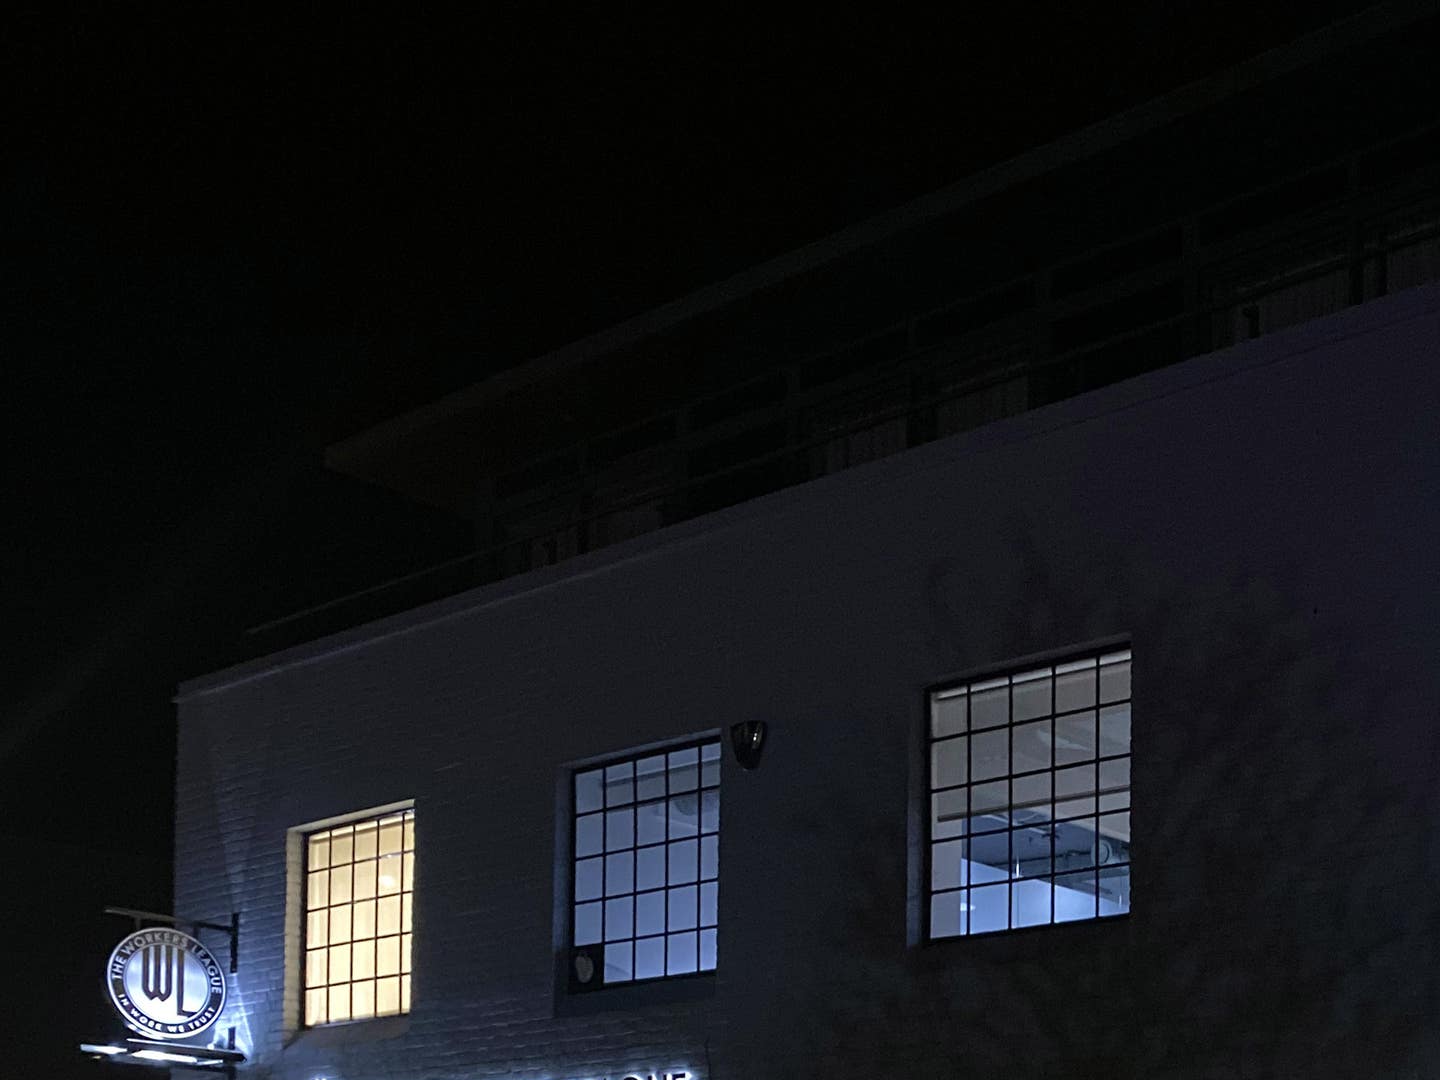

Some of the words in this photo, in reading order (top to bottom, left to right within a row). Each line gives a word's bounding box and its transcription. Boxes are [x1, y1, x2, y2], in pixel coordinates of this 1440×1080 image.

[111, 955, 127, 980] THE
[120, 932, 188, 956] WORKERS
[191, 944, 222, 995] LEAGUE
[187, 1007, 215, 1030] TRUST
